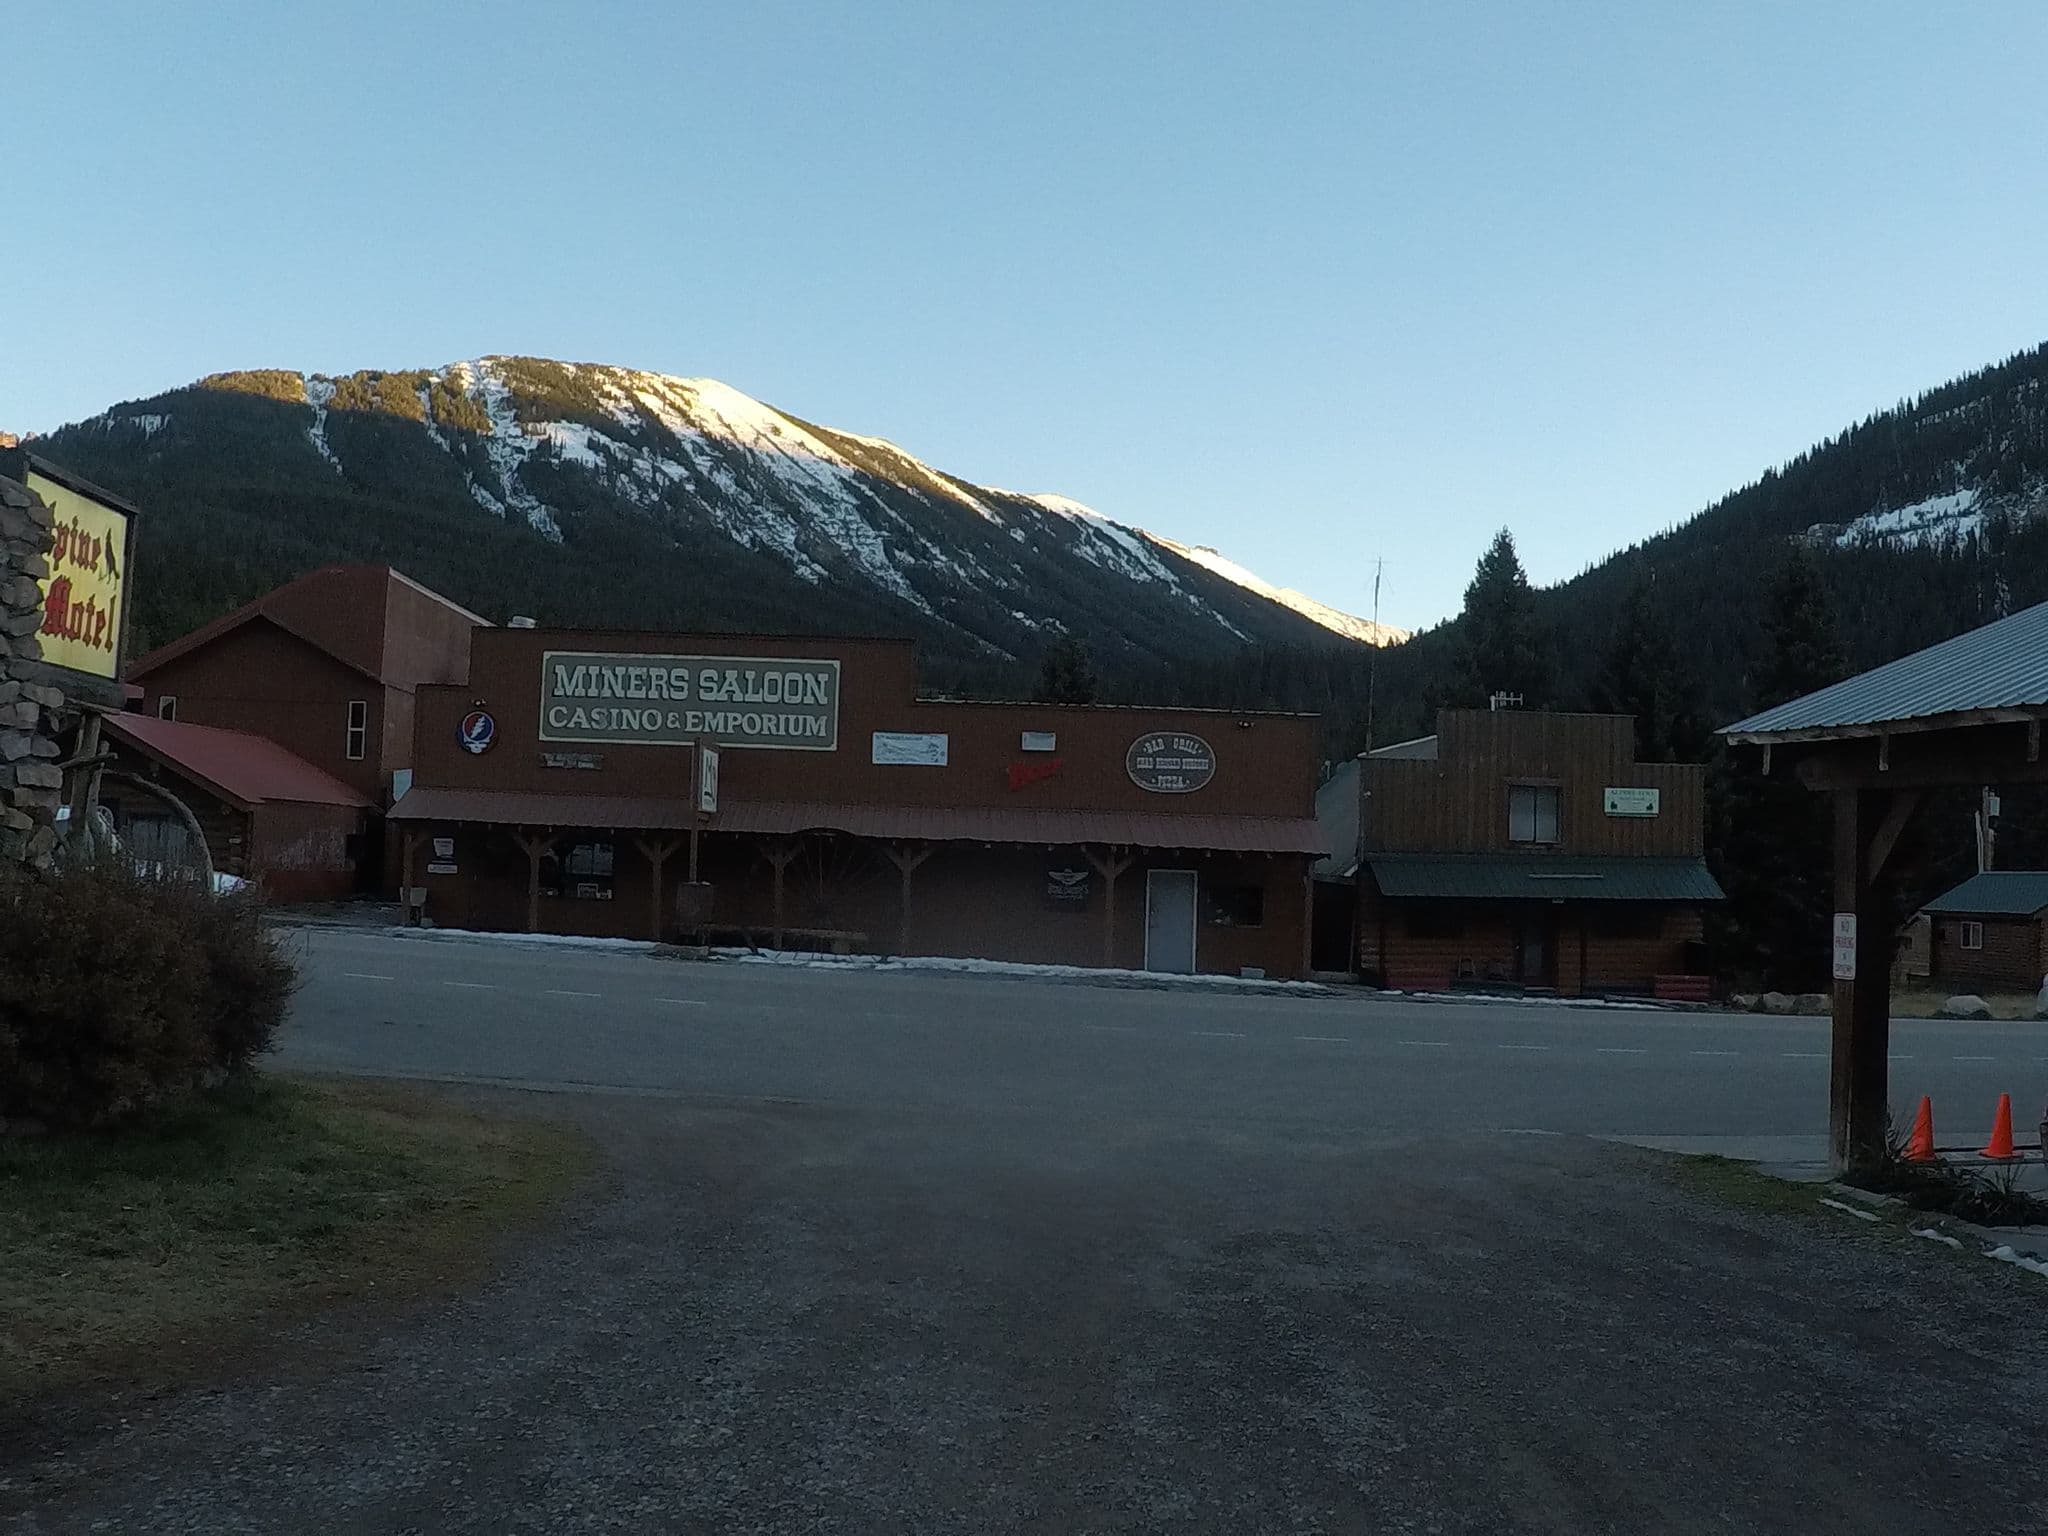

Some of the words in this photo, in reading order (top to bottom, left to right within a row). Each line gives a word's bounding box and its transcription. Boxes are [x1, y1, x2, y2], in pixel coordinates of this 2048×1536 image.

[41, 574, 116, 653] Motel
[553, 664, 690, 700] MINERS
[698, 667, 829, 705] SALOON
[549, 706, 663, 731] CASINO
[667, 712, 681, 729] &
[684, 710, 828, 737] EMPORIUM
